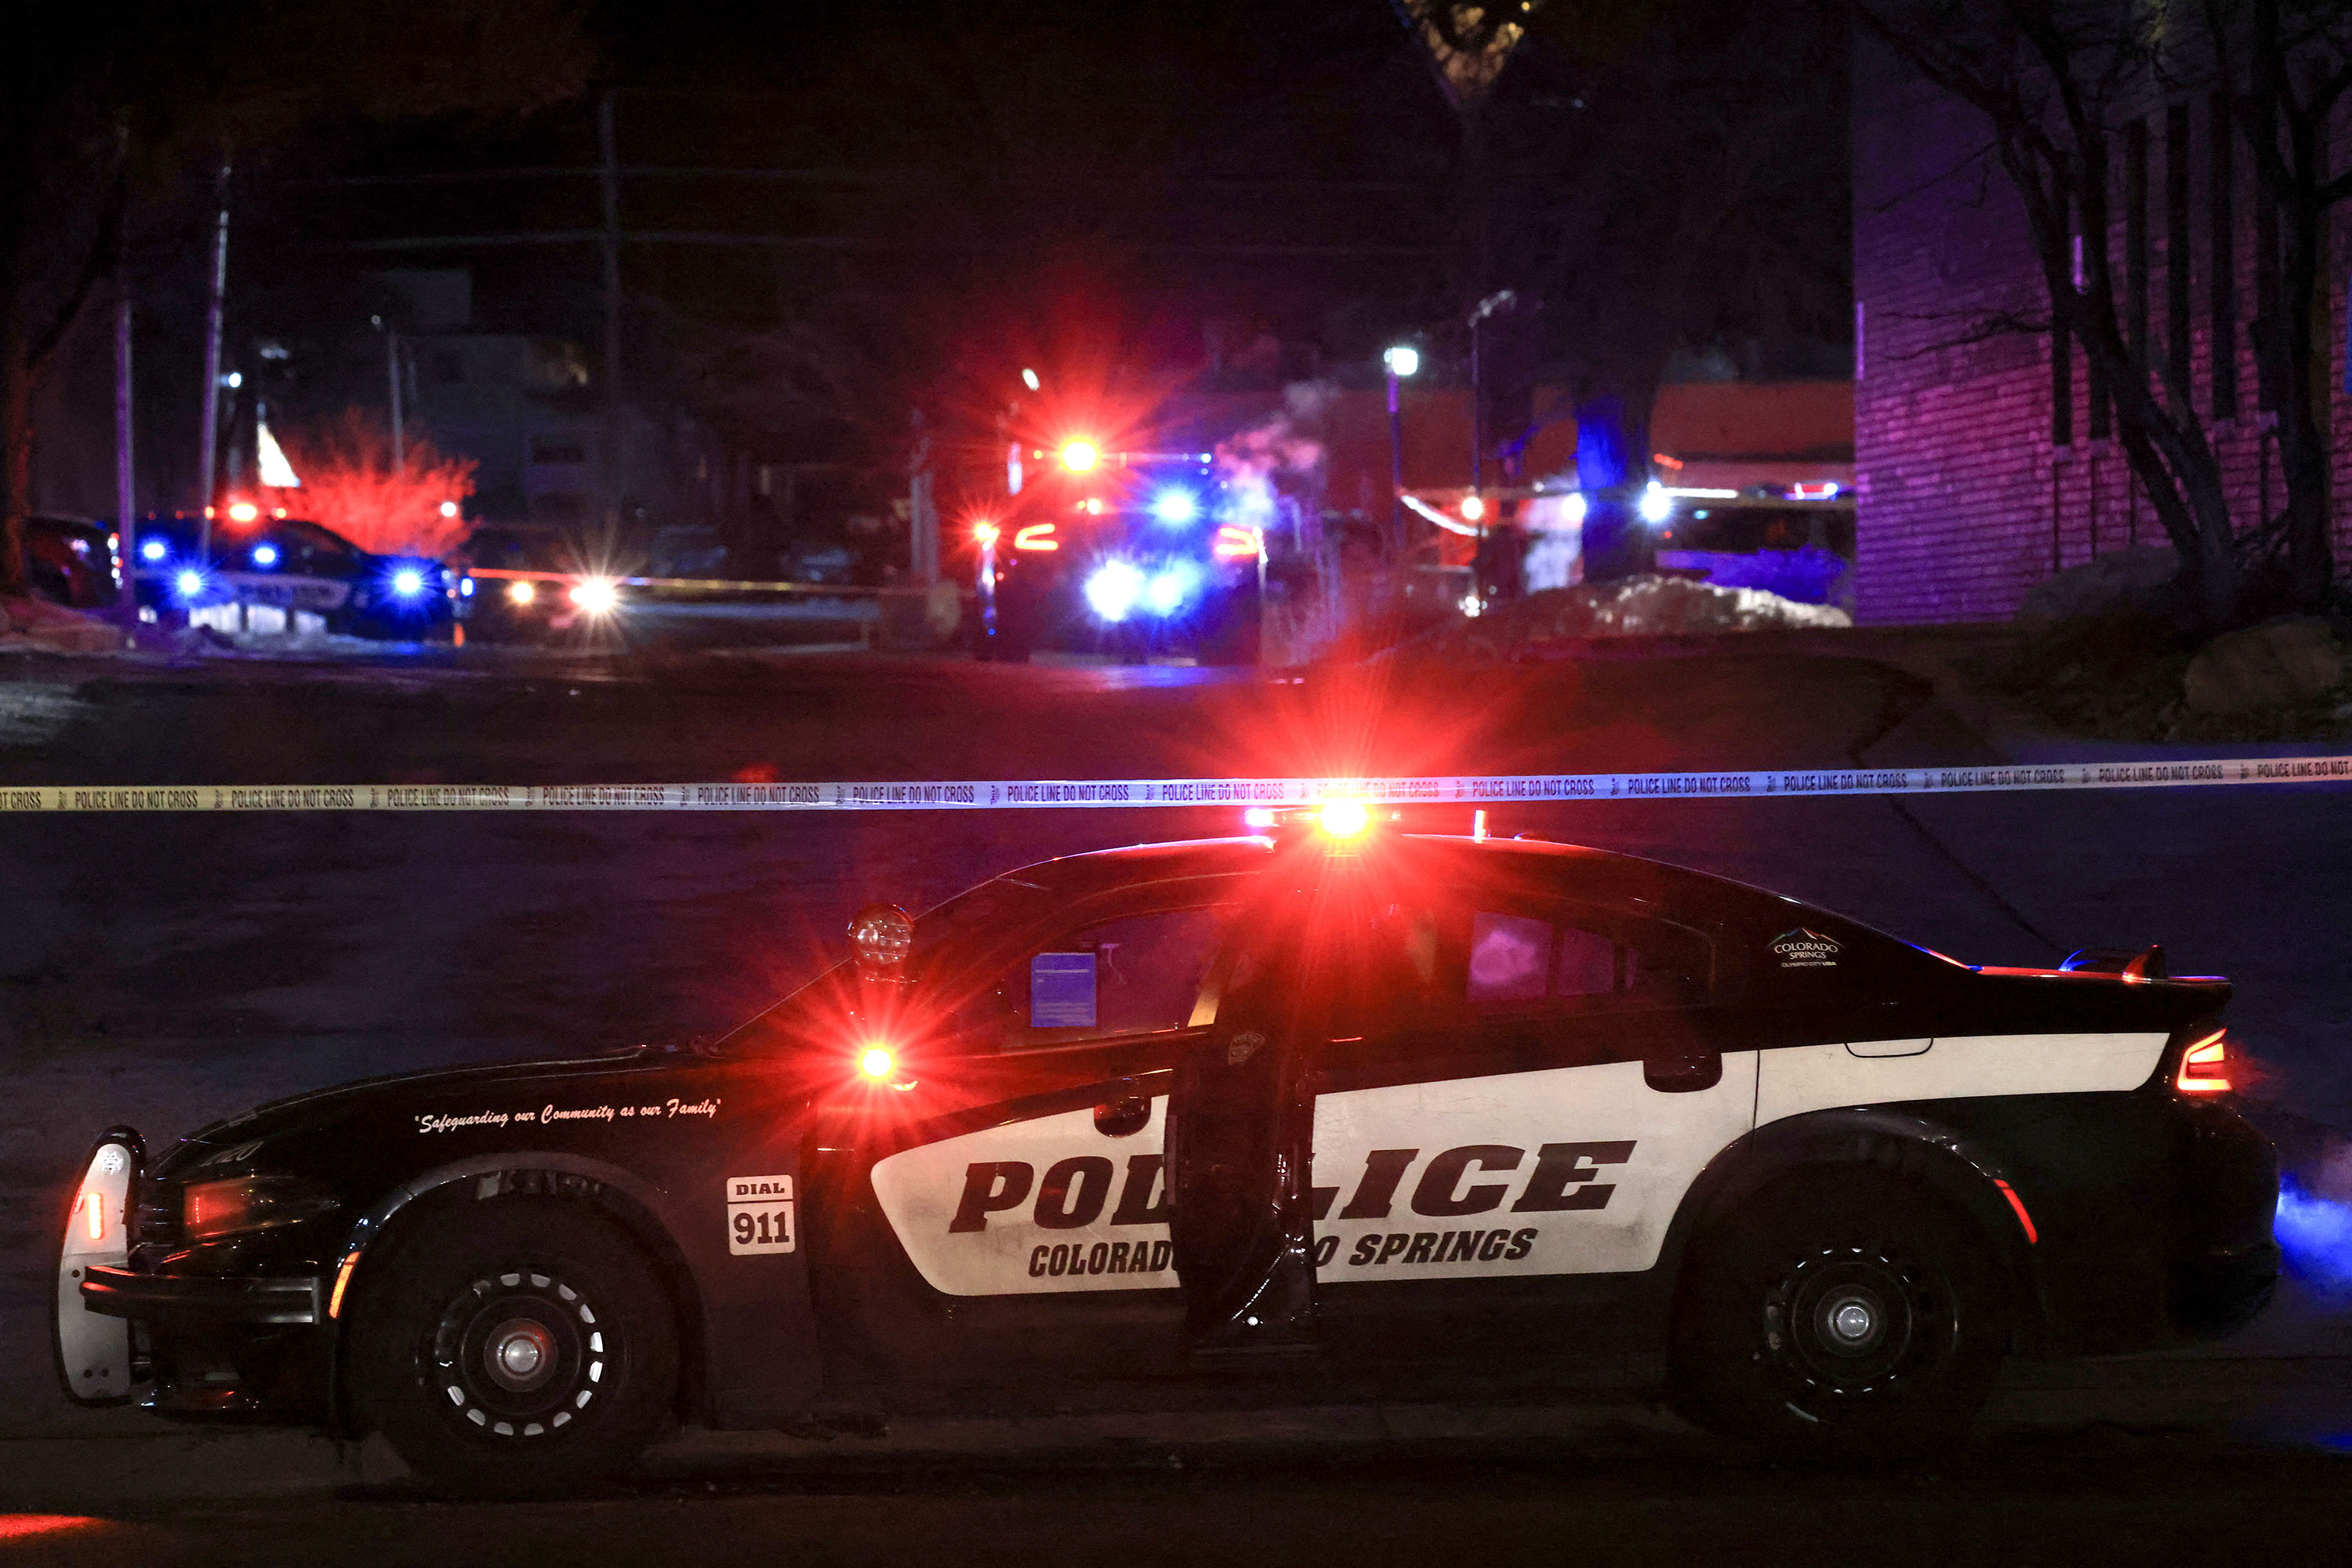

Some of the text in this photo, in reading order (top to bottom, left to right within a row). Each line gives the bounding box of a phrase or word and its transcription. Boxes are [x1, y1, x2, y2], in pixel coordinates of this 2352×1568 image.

[1941, 771, 1973, 787] POLICE
[1975, 771, 1995, 786] LINE
[1998, 770, 2012, 786] DO
[2013, 770, 2031, 785] NOT
[2034, 769, 2064, 784] CROSS
[2100, 768, 2132, 782] POLICE
[2133, 767, 2154, 782] LINE
[2157, 766, 2170, 781] DO
[2172, 765, 2190, 781] NOT
[2193, 764, 2223, 780] CROSS
[2258, 763, 2290, 779] POLICE
[2292, 762, 2313, 777] LINE
[2315, 761, 2328, 776] DO
[2331, 760, 2349, 776] NOT
[1163, 784, 1193, 800] POLICE
[1196, 784, 1215, 800] LINE
[1218, 783, 1232, 800] DO
[1233, 783, 1251, 800] NOT
[1253, 783, 1283, 800] CROSS
[1388, 782, 1406, 798] NOT
[1409, 782, 1439, 797] CROSS
[1473, 780, 1504, 797] POLICE
[1506, 780, 1526, 797] LINE
[1529, 779, 1542, 796] DO
[1544, 779, 1562, 796] NOT
[1563, 779, 1594, 795] CROSS
[1628, 778, 1660, 794] POLICE
[1662, 778, 1682, 793] LINE
[1685, 777, 1697, 793] DO
[1700, 777, 1717, 793] NOT
[1719, 776, 1750, 793] CROSS
[1784, 775, 1816, 792] POLICE
[1818, 775, 1838, 790] LINE
[1841, 775, 1854, 790] DO
[1857, 775, 1874, 789] NOT
[1876, 774, 1907, 789] CROSS
[10, 791, 42, 810] CROSS
[75, 791, 107, 809] POLICE
[109, 791, 129, 808] LINE
[132, 791, 145, 808] DO
[147, 791, 165, 808] NOT
[167, 791, 198, 808] CROSS
[232, 790, 263, 808] POLICE
[265, 789, 285, 808] LINE
[289, 789, 301, 808] DO
[303, 789, 321, 808] NOT
[323, 789, 354, 808] CROSS
[388, 789, 419, 807] POLICE
[421, 789, 441, 807] LINE
[444, 789, 457, 807] DO
[459, 789, 477, 806] NOT
[478, 788, 509, 806] CROSS
[543, 787, 574, 805] POLICE
[576, 787, 596, 805] LINE
[599, 787, 612, 805] DO
[614, 787, 631, 805] NOT
[633, 787, 664, 805] CROSS
[699, 787, 729, 805] POLICE
[731, 786, 751, 805] LINE
[754, 786, 767, 804] DO
[769, 786, 786, 804] NOT
[789, 786, 819, 804] CROSS
[853, 786, 884, 804] POLICE
[886, 786, 906, 804] LINE
[909, 786, 922, 804] DO
[924, 786, 942, 803] NOT
[944, 786, 974, 803] CROSS
[1008, 786, 1039, 802] POLICE
[1041, 785, 1061, 801] LINE
[1064, 785, 1076, 801] DO
[1079, 785, 1096, 801] NOT
[1098, 785, 1128, 801] CROSS
[1774, 942, 1838, 954] COLORADO
[1789, 951, 1827, 960] SPRINGS
[514, 1111, 536, 1122] our
[540, 1104, 615, 1124] Community
[620, 1106, 636, 1117] as
[640, 1105, 662, 1116] our
[735, 1182, 786, 1196] DIAL
[733, 1211, 789, 1245] 911
[1348, 1228, 1539, 1266] SPRINGS
